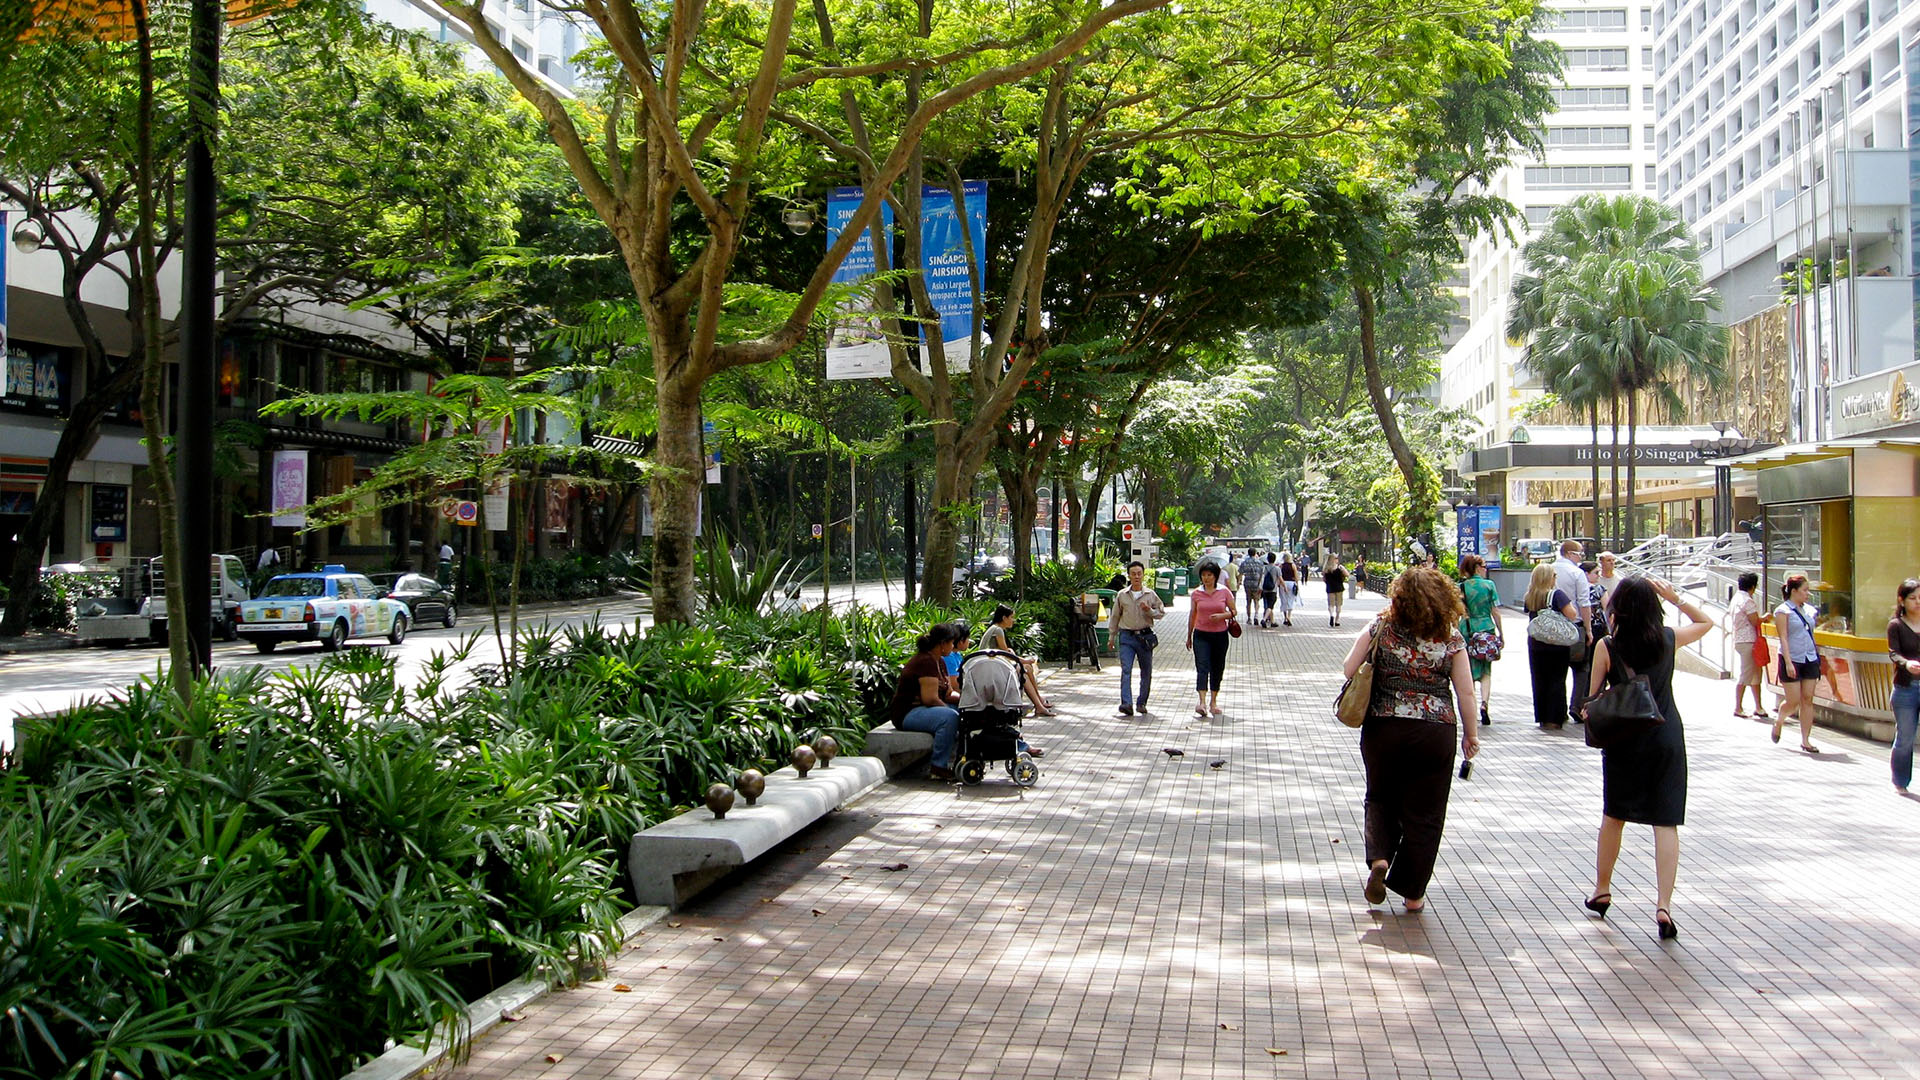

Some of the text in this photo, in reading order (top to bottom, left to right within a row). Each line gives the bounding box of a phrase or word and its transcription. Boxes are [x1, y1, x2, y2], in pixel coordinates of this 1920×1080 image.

[928, 254, 968, 266] SINGAPO
[932, 266, 969, 277] AIRSHOW
[931, 280, 971, 290] Asia's Largest
[958, 289, 972, 298] Even
[1577, 448, 1621, 460] Hito
[1460, 541, 1475, 552] 24
